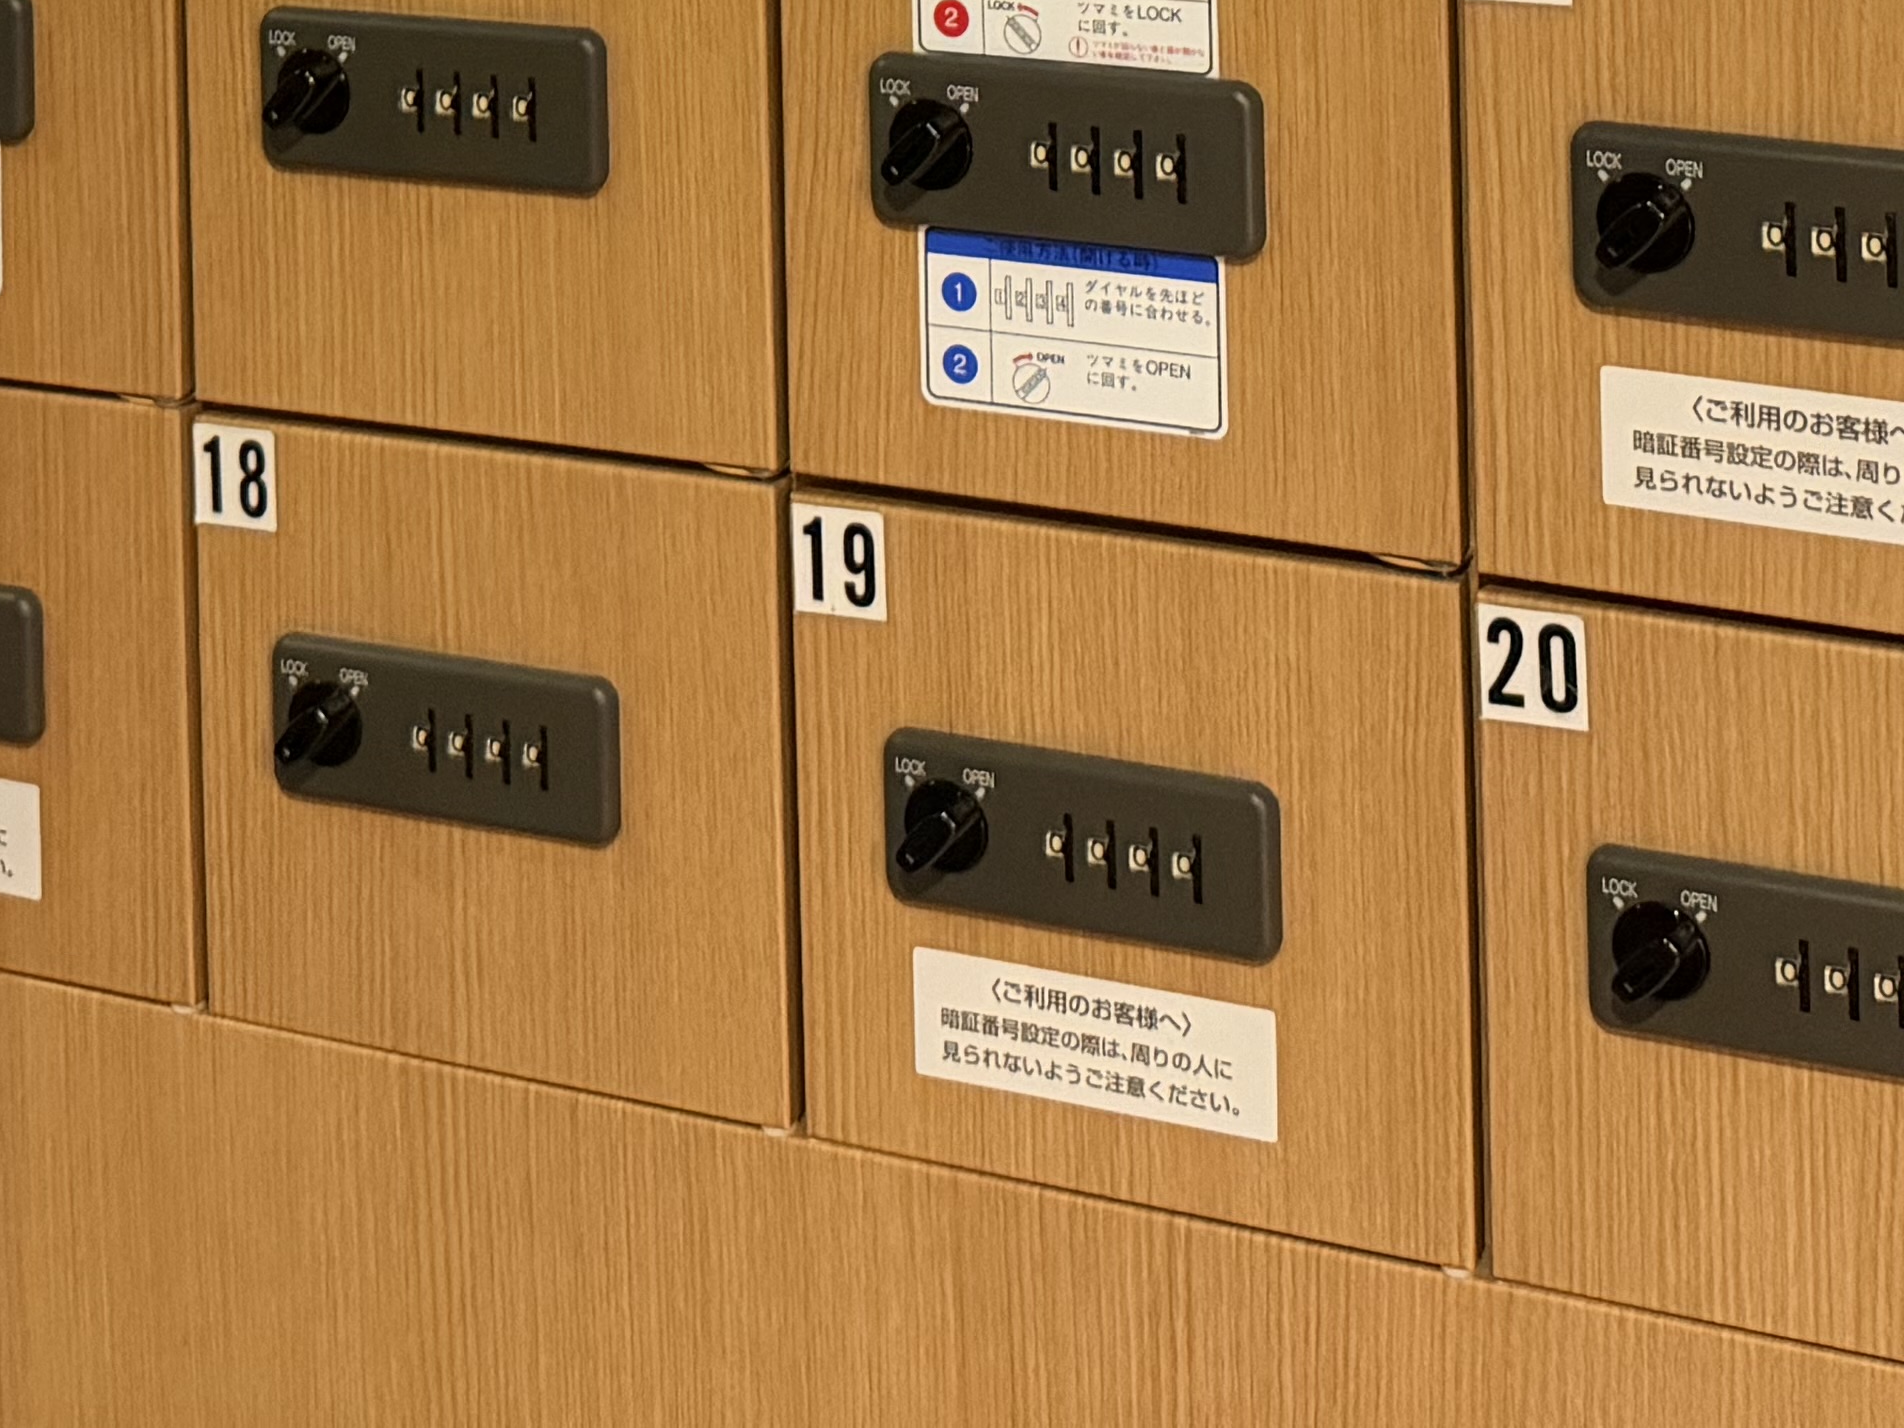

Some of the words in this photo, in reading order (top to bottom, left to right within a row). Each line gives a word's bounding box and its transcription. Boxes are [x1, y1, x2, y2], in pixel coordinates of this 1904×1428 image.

[988, 0, 1015, 11] LOCK
[1077, 1, 1182, 23] ツマミをLOCK
[269, 29, 295, 45] LOCK
[328, 35, 355, 51] OPEN
[1078, 19, 1128, 37] に回す。
[880, 78, 911, 97] LOCK
[947, 85, 979, 102] OPEN
[1587, 150, 1622, 172] LOCK
[1666, 158, 1704, 180] OPEN
[1085, 279, 1205, 306] ダイヤルを先ほど
[1085, 298, 1211, 327] の番号に合わせる。
[1037, 352, 1064, 365] OPEN
[1086, 354, 1191, 380] ツマミをOPEN
[1087, 372, 1136, 392] に回す。
[204, 435, 268, 518] 18
[802, 515, 876, 607] 19
[280, 658, 308, 676] LOCK
[339, 667, 368, 686] OPEN
[1487, 616, 1578, 714] 20
[896, 756, 926, 776] LOCK
[963, 767, 995, 788] OPEN
[1602, 877, 1637, 898] LOCK
[1681, 889, 1718, 912] OPEN
[941, 1007, 1233, 1081] 暗証番号設定の際は、周りの人に
[942, 1039, 1242, 1116] 見られないようご注意ください。
